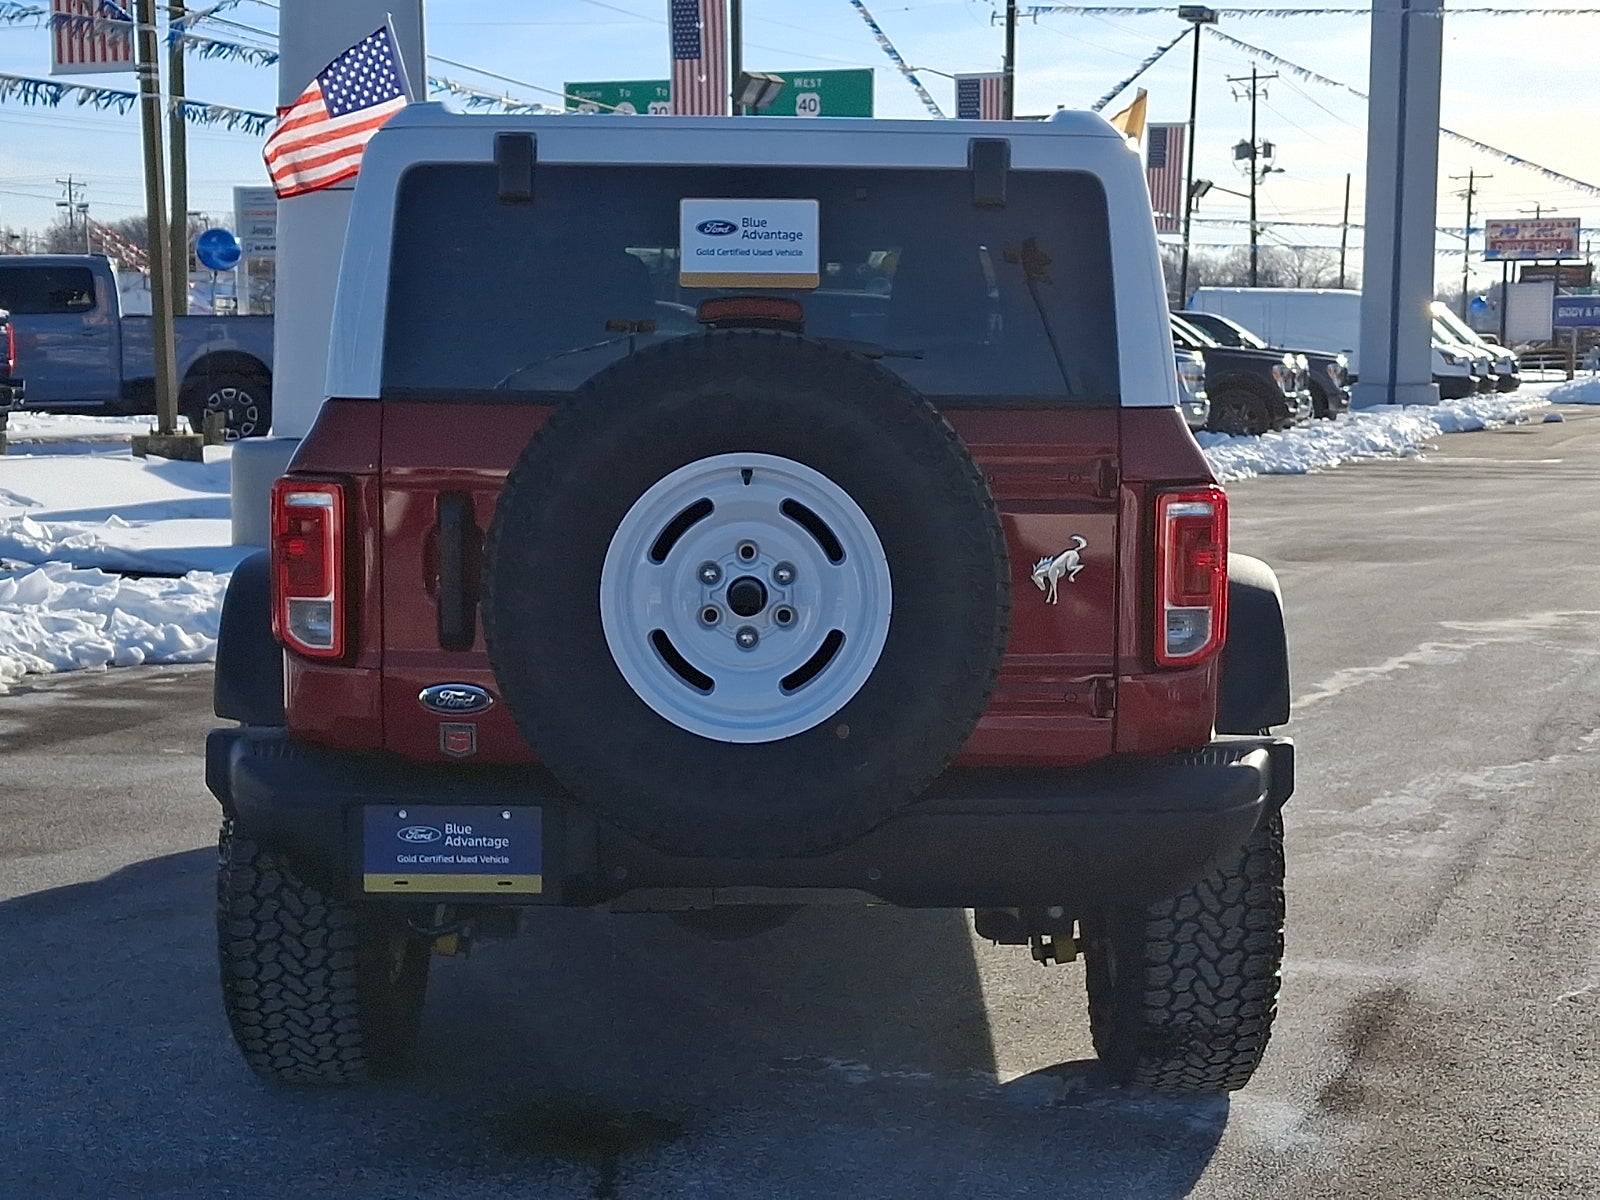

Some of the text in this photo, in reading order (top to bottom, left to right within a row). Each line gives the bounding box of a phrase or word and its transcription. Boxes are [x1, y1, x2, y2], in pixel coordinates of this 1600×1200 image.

[793, 78, 822, 88] WEST
[798, 98, 818, 112] 40
[742, 217, 768, 228] Blue
[741, 229, 803, 242] Advantage
[696, 247, 803, 256] Gold Certified Used Vehicle
[1558, 307, 1584, 317] BODY
[444, 823, 472, 835] Blue
[444, 835, 510, 849] Advantage
[396, 854, 510, 864] Gold Certified Used Vehicle
